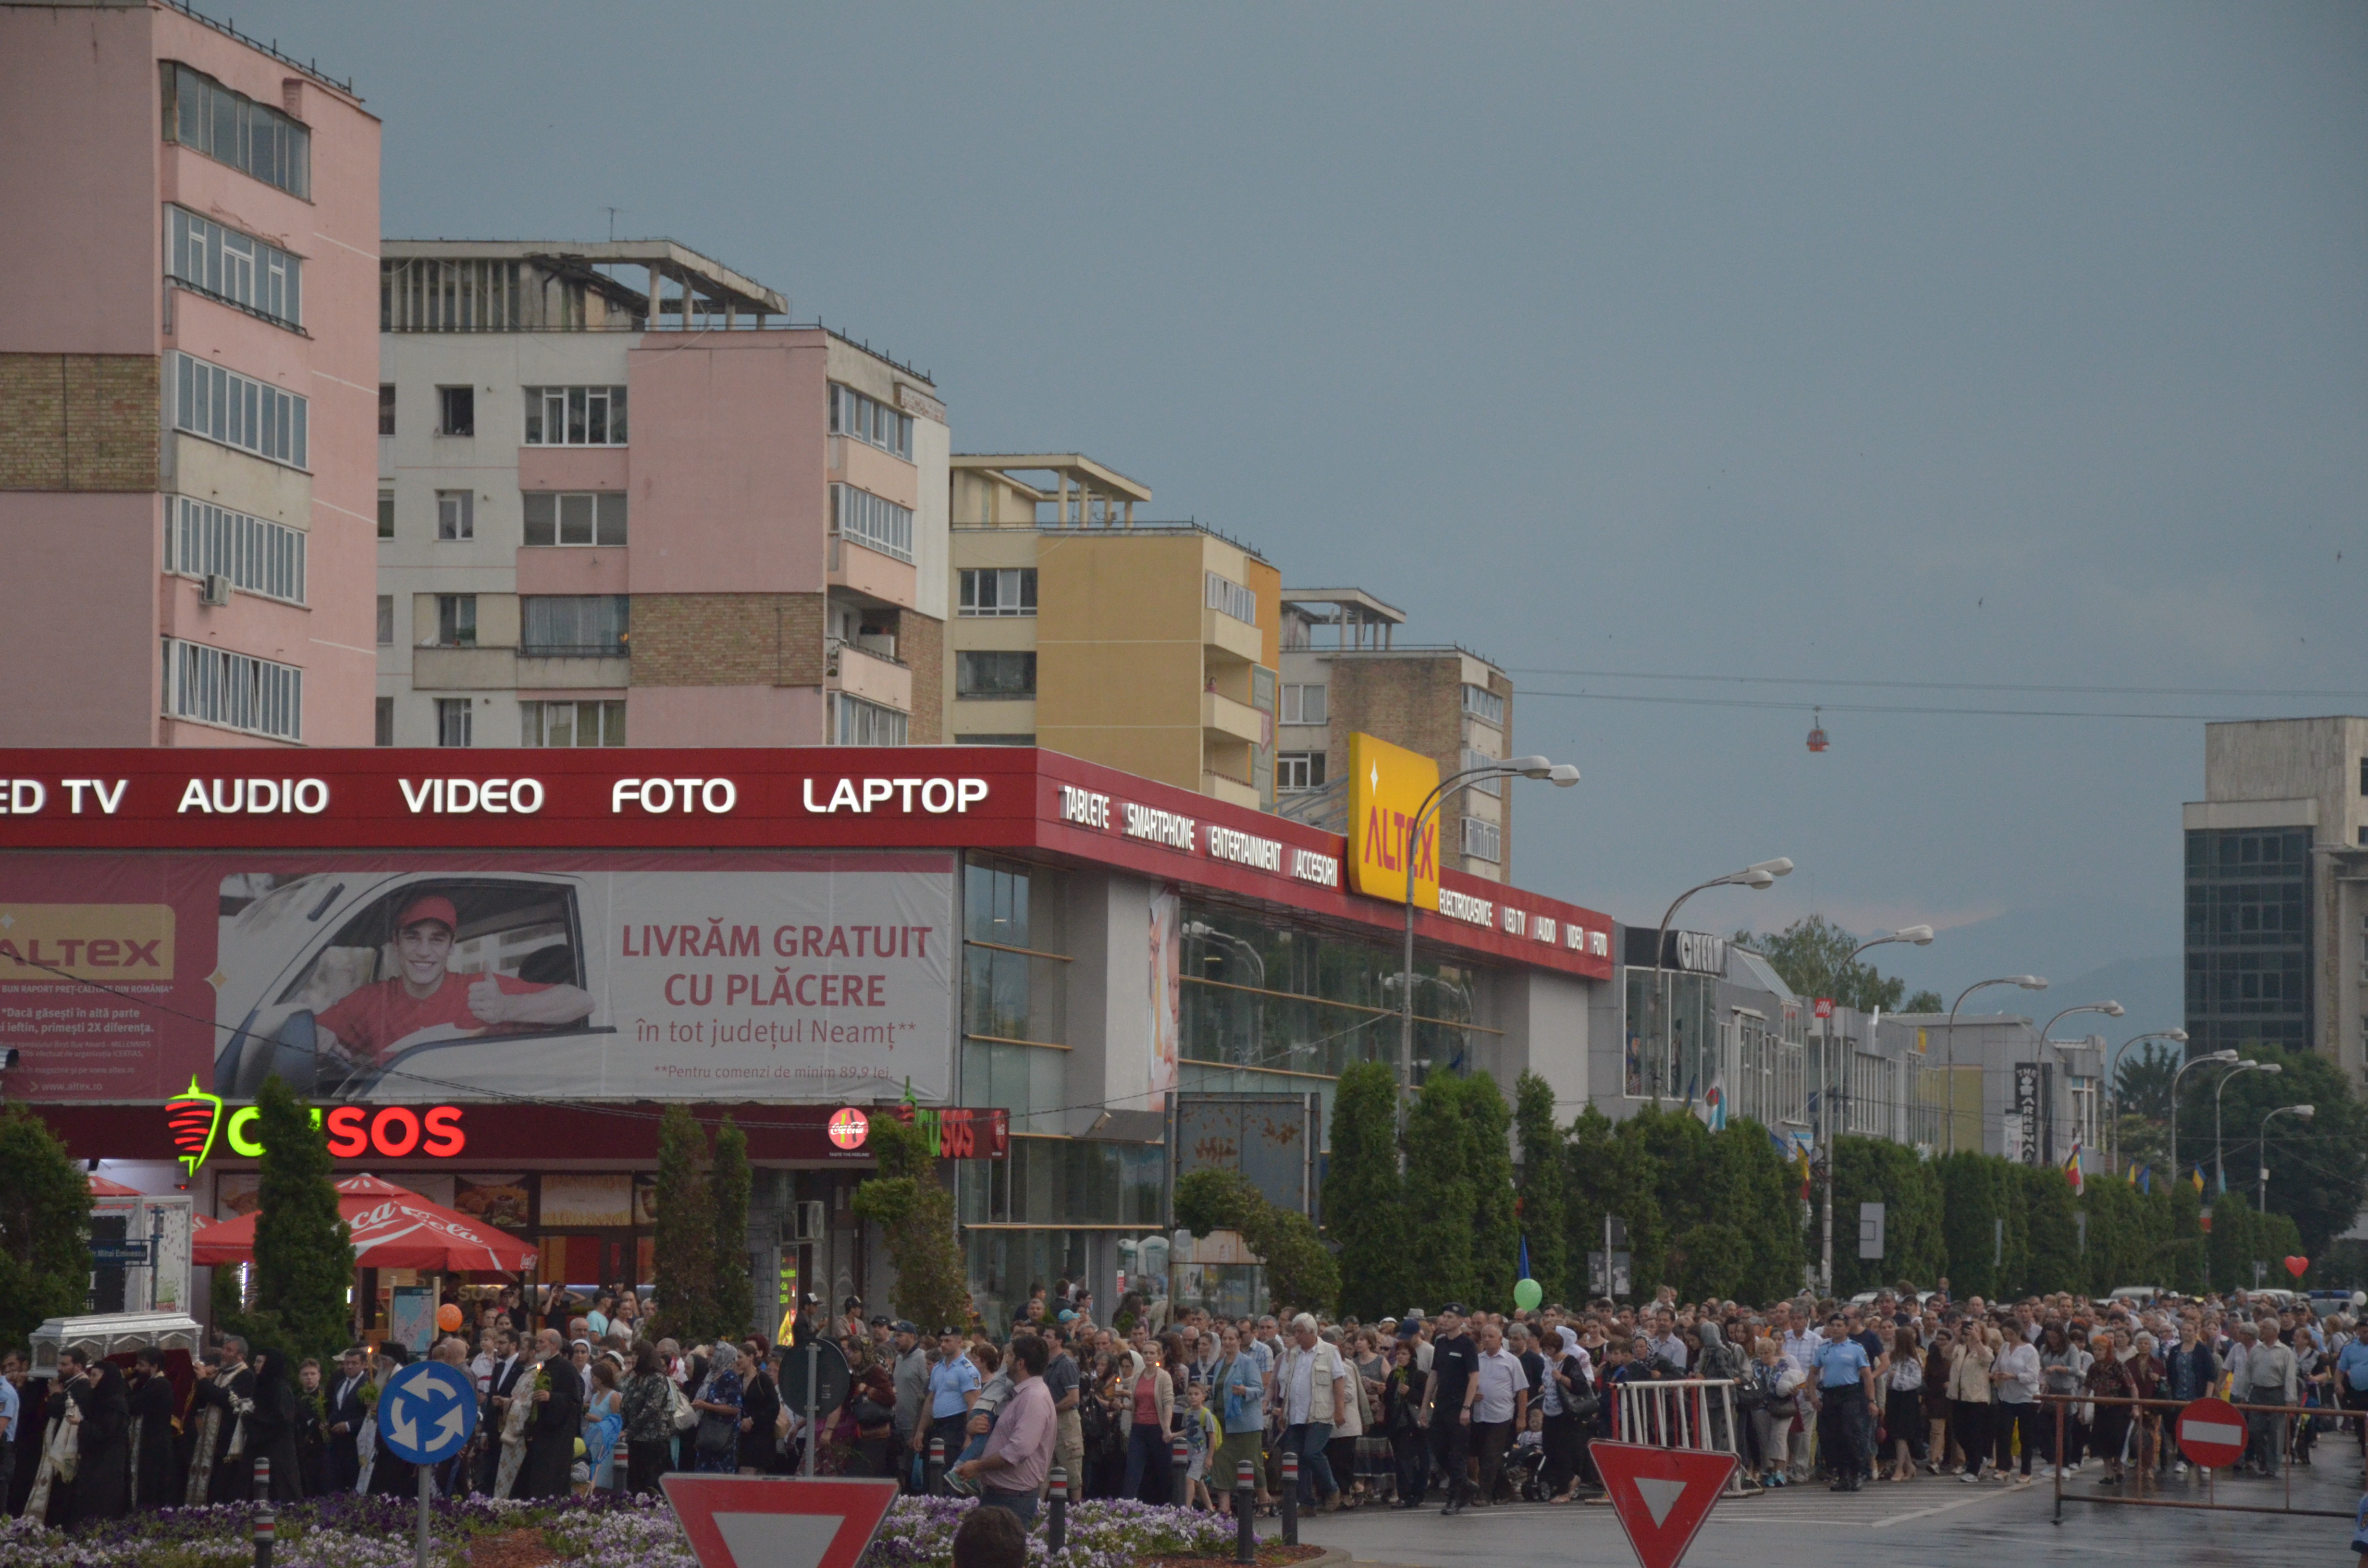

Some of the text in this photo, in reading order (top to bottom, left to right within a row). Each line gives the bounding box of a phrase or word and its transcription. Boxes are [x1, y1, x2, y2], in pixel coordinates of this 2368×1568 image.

[0, 778, 988, 813] D TV AUDIO VIDEO FOTO LAPTOP
[1064, 785, 1338, 887] TABLETE SMARTPHONE ENTERTAINMENT ACCESORII
[622, 917, 933, 957] LIVRĂM GRATUIT
[1439, 888, 1492, 928] ELECTROCASNICE
[1539, 916, 1556, 944] AUDIO
[1567, 923, 1583, 951] VIDEO
[1593, 931, 1607, 957] FOTO
[665, 966, 886, 1006] CU PLĂCERE
[35, 1007, 74, 1020] găsești
[77, 1007, 86, 1018] în
[89, 1007, 110, 1018] altă
[112, 1009, 140, 1021] parte
[1816, 1001, 1831, 1017] illy
[7, 1022, 38, 1034] ieftin,
[41, 1022, 85, 1035] primești
[87, 1022, 102, 1032] 2X
[104, 1022, 154, 1035] diferența.
[635, 1017, 659, 1042] în
[669, 1020, 703, 1043] tot
[711, 1018, 802, 1051] județul
[41, 1082, 102, 1091] www.altex.ro
[715, 1065, 770, 1078] comenzi
[774, 1065, 790, 1078] de
[795, 1066, 835, 1078] minim
[839, 1066, 869, 1080] 89,9
[873, 1066, 893, 1078] lei.
[228, 1106, 466, 1157] CSOS
